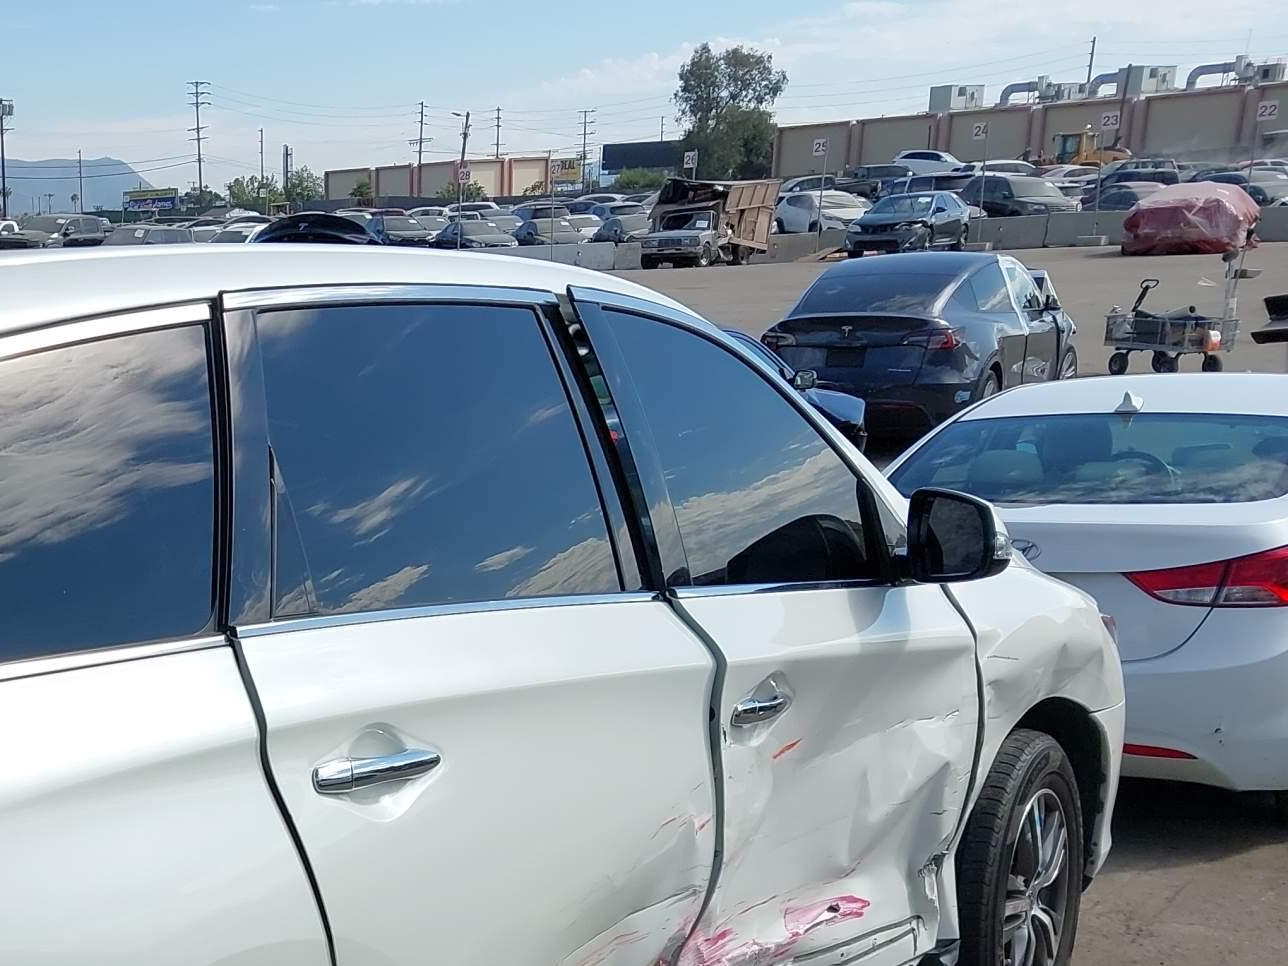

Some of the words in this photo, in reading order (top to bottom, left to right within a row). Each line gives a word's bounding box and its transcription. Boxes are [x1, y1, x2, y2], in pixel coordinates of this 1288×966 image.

[1258, 104, 1277, 118] 22
[1103, 115, 1119, 127] 23
[974, 125, 988, 137] 24
[814, 142, 827, 153] 25
[552, 164, 561, 175] 27
[459, 170, 471, 181] 28
